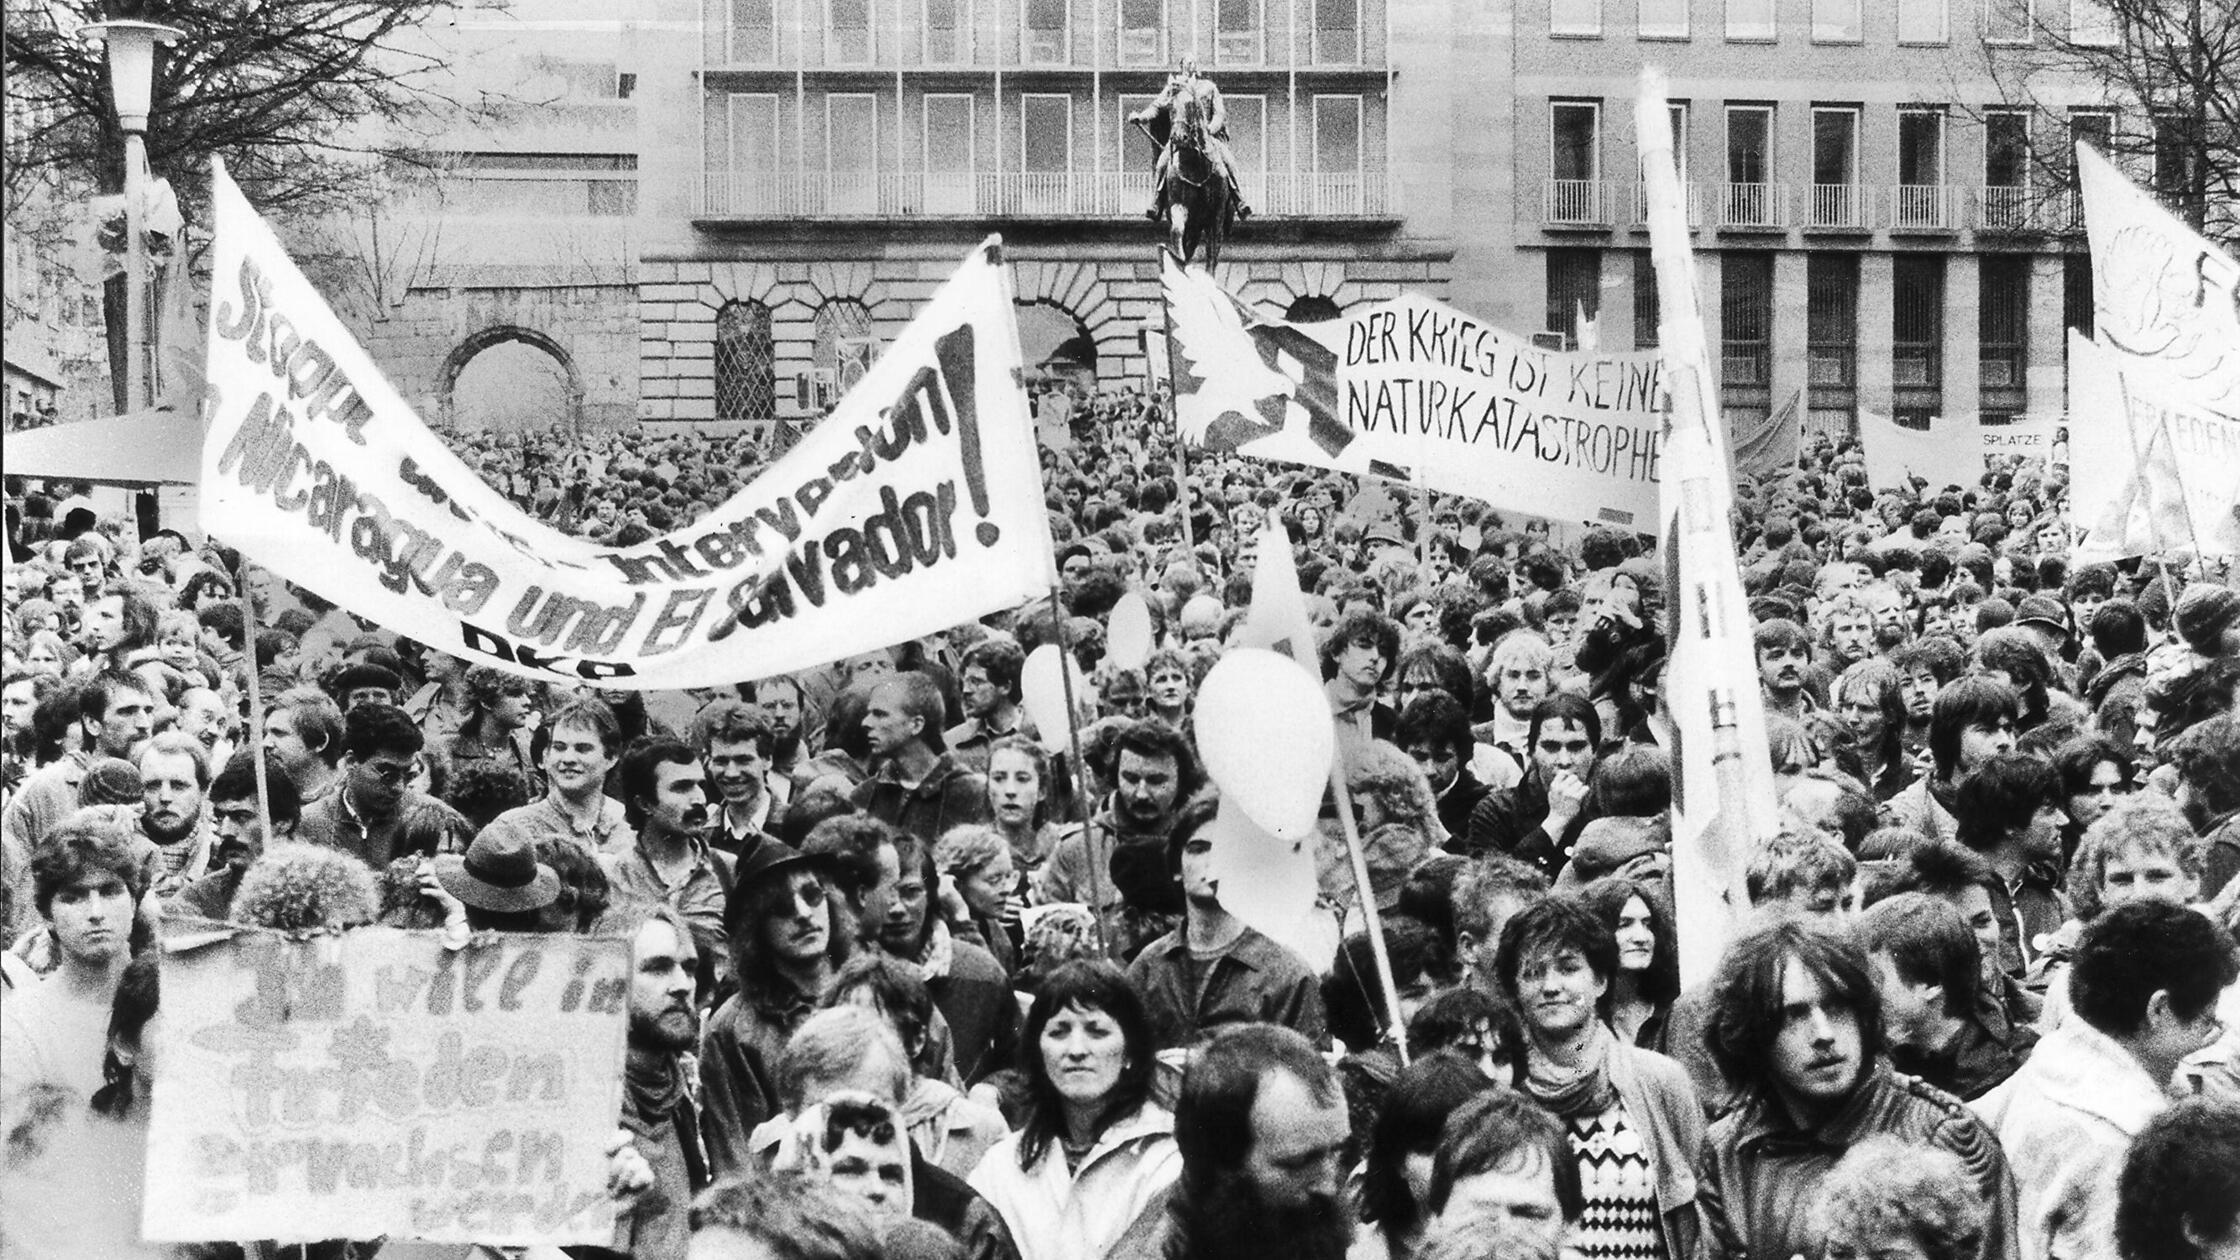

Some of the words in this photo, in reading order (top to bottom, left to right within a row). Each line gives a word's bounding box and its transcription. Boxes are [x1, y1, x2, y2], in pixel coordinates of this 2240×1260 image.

[1346, 310, 1399, 366] DER
[1408, 307, 1499, 378] KRIEG
[1508, 348, 1552, 397] IST
[1568, 357, 1663, 413] KEINE
[1346, 378, 1661, 482] NATURKATASTROPHE
[218, 391, 500, 616] Nicaragua
[506, 585, 647, 656] und
[638, 587, 717, 657] El
[375, 938, 543, 1018] will
